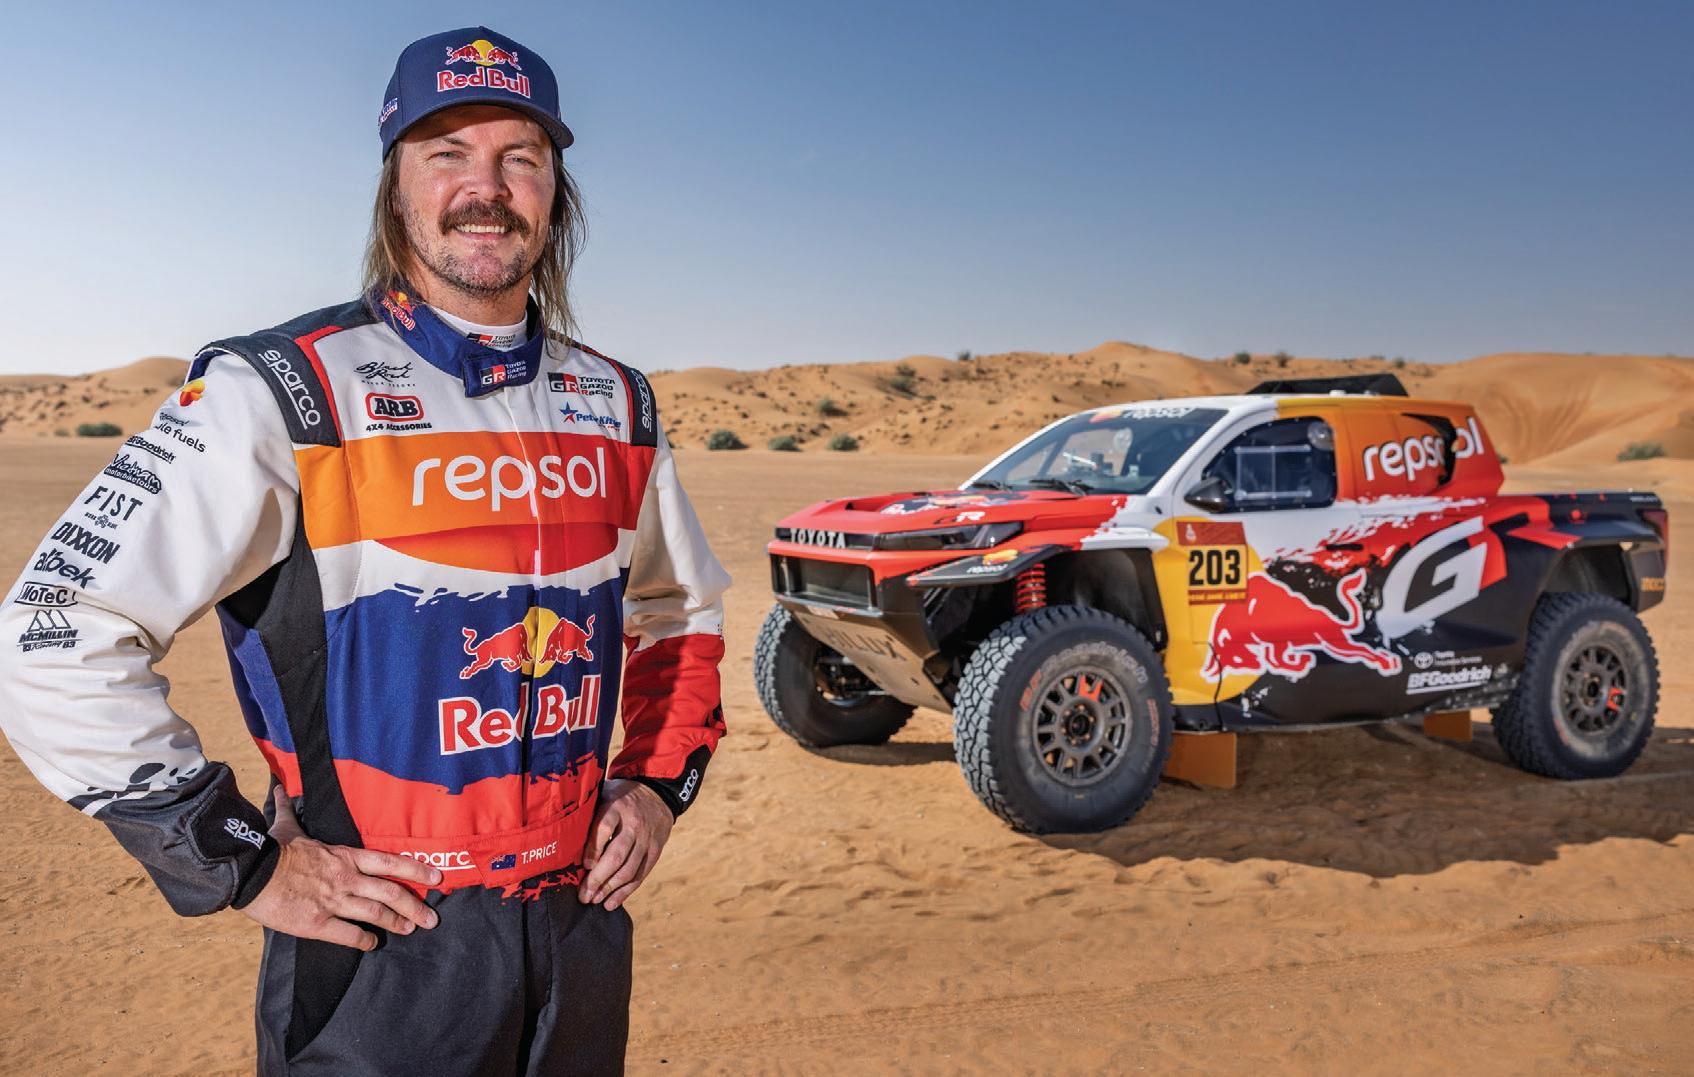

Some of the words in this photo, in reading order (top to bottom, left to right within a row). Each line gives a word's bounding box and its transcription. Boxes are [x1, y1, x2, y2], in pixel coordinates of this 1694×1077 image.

[437, 66, 485, 92] Red
[487, 67, 530, 98] Bull
[395, 310, 416, 331] Bull
[259, 350, 321, 428] sparco
[482, 371, 505, 385] GR
[551, 380, 579, 393] GR
[578, 376, 616, 385] TOYOTA
[580, 383, 613, 391] GAZOO
[581, 389, 613, 399] Racing
[374, 397, 418, 417] ARB
[386, 422, 432, 431] ACCESSORIES
[173, 428, 206, 453] fuels
[412, 447, 607, 517] repsol
[84, 486, 143, 521] FIST
[51, 522, 120, 564] DIXXON
[790, 528, 846, 549] TOYOTA
[1189, 549, 1240, 586] 203
[1406, 665, 1492, 691] BFGoodrich
[532, 674, 601, 739] Bull
[521, 841, 557, 865] T.PRICE
